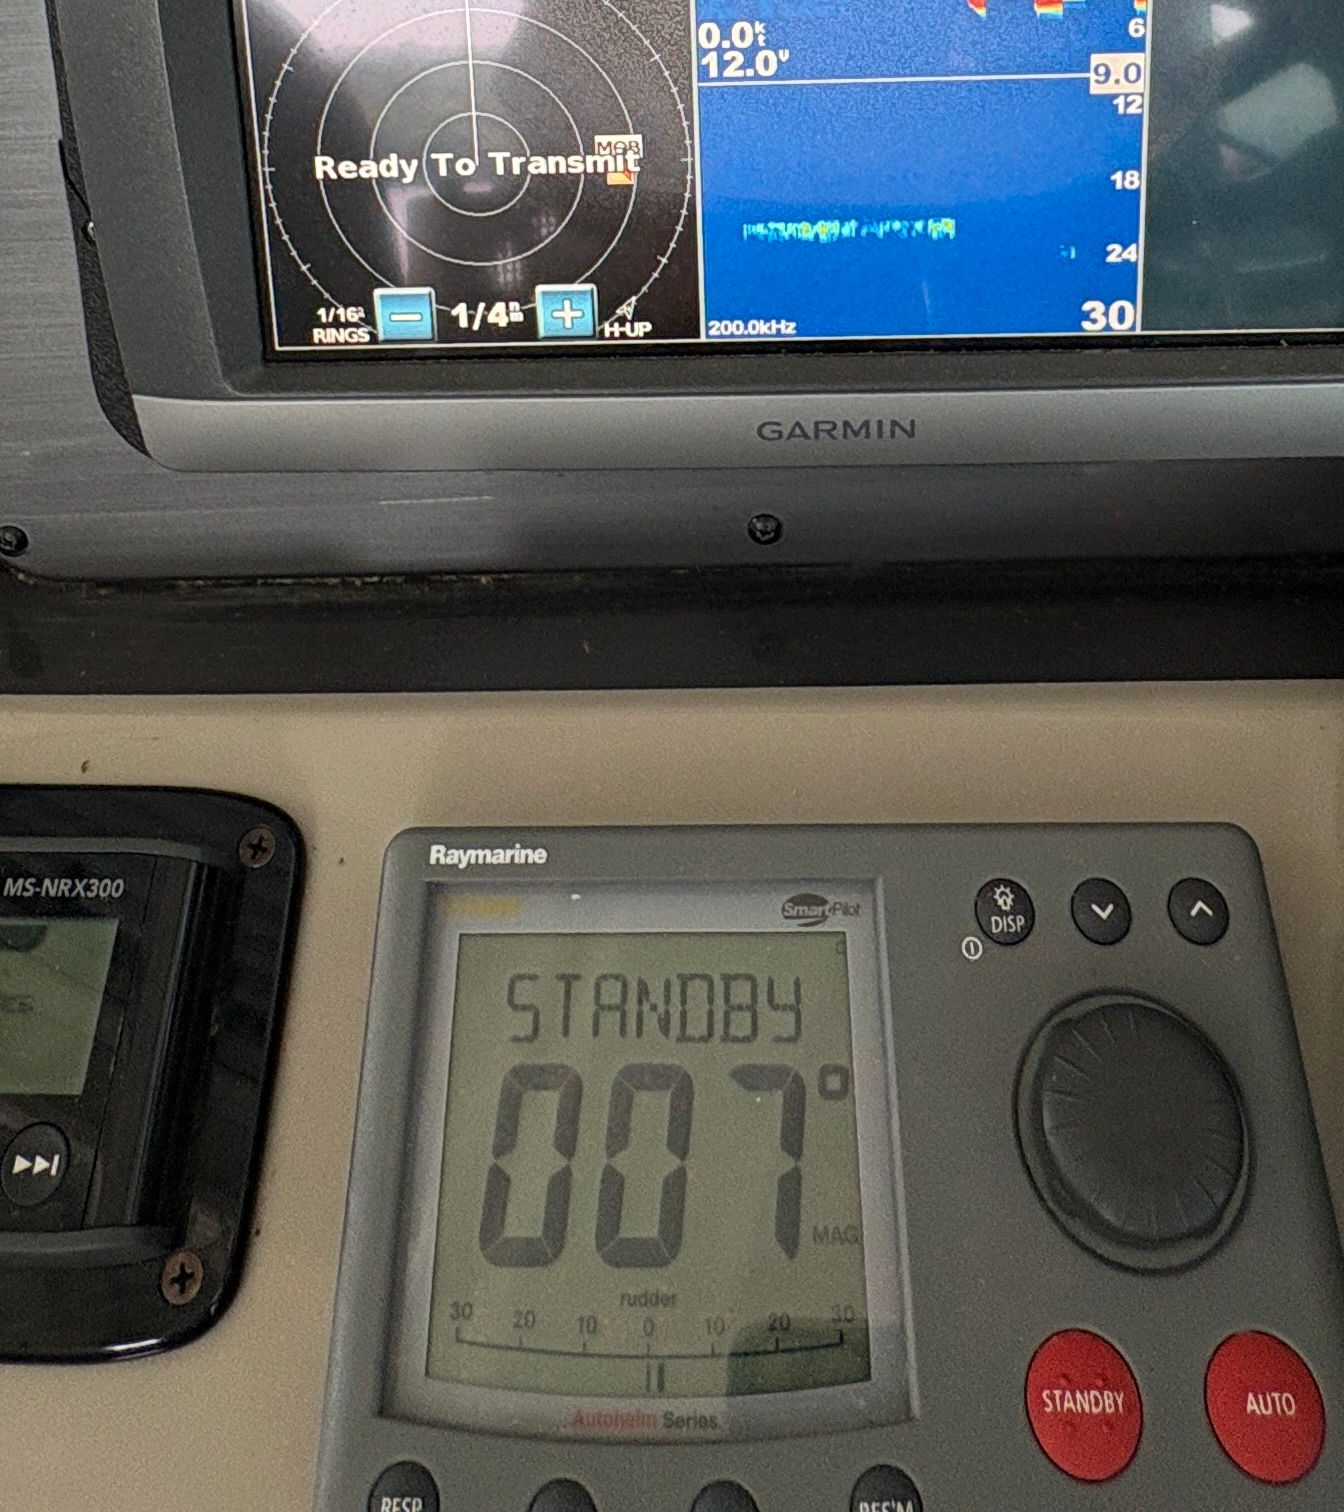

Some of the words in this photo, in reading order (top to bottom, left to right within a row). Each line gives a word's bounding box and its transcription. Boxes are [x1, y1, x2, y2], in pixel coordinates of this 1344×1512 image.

[1128, 17, 1146, 38] 6
[1092, 62, 1143, 85] 9.0
[1112, 94, 1143, 115] 12
[314, 154, 419, 186] Ready
[430, 152, 477, 178] To
[488, 149, 641, 176] Transmit
[1110, 170, 1141, 191] 18
[1105, 243, 1138, 263] 24
[1080, 299, 1136, 332] 30
[312, 326, 371, 344] RINGS
[604, 321, 653, 339] H-UP
[708, 318, 797, 337] 200.0kHz
[755, 418, 917, 442] GARMIN
[428, 842, 549, 870] Raymarine
[2, 876, 125, 899] MS-NRX300
[989, 913, 1027, 935] DISP
[506, 972, 804, 1045] STANDBY
[619, 1290, 678, 1309] rudder
[449, 1301, 474, 1322] 30
[512, 1310, 536, 1330] 20
[577, 1315, 598, 1335] 10
[706, 1315, 726, 1336] 10
[768, 1312, 791, 1332] 20
[1042, 1388, 1125, 1415] STANDBY
[1245, 1391, 1297, 1416] AUTO
